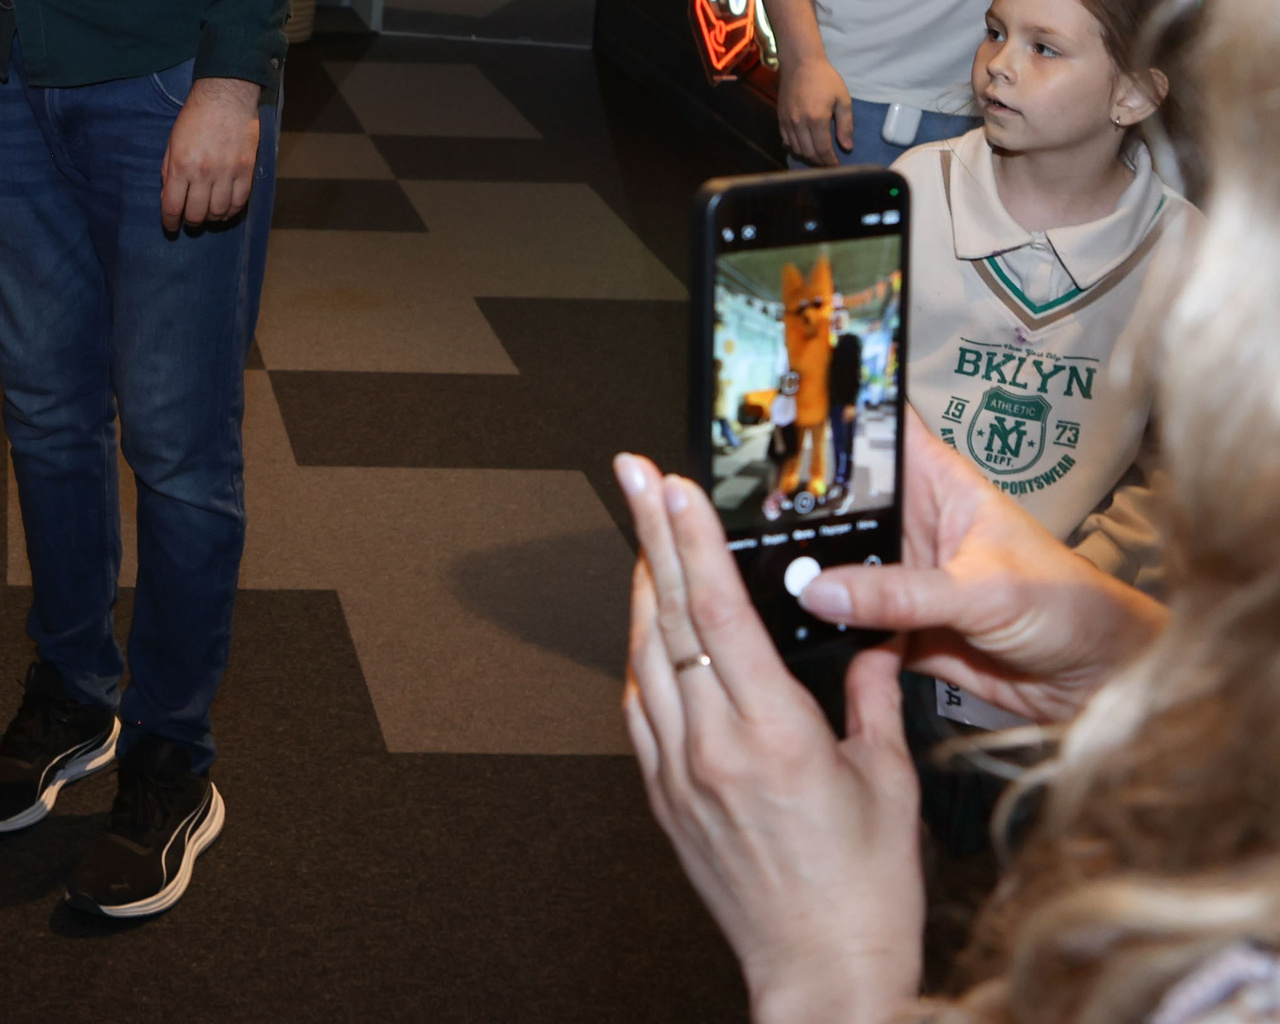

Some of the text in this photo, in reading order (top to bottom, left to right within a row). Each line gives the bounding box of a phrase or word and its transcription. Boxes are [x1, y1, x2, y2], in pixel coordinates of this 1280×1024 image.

[954, 346, 1097, 400] BKLYN
[943, 399, 967, 420] 19
[990, 399, 1036, 417] ATHLETIC
[1055, 424, 1081, 444] 73
[985, 453, 1015, 468] DEPT.
